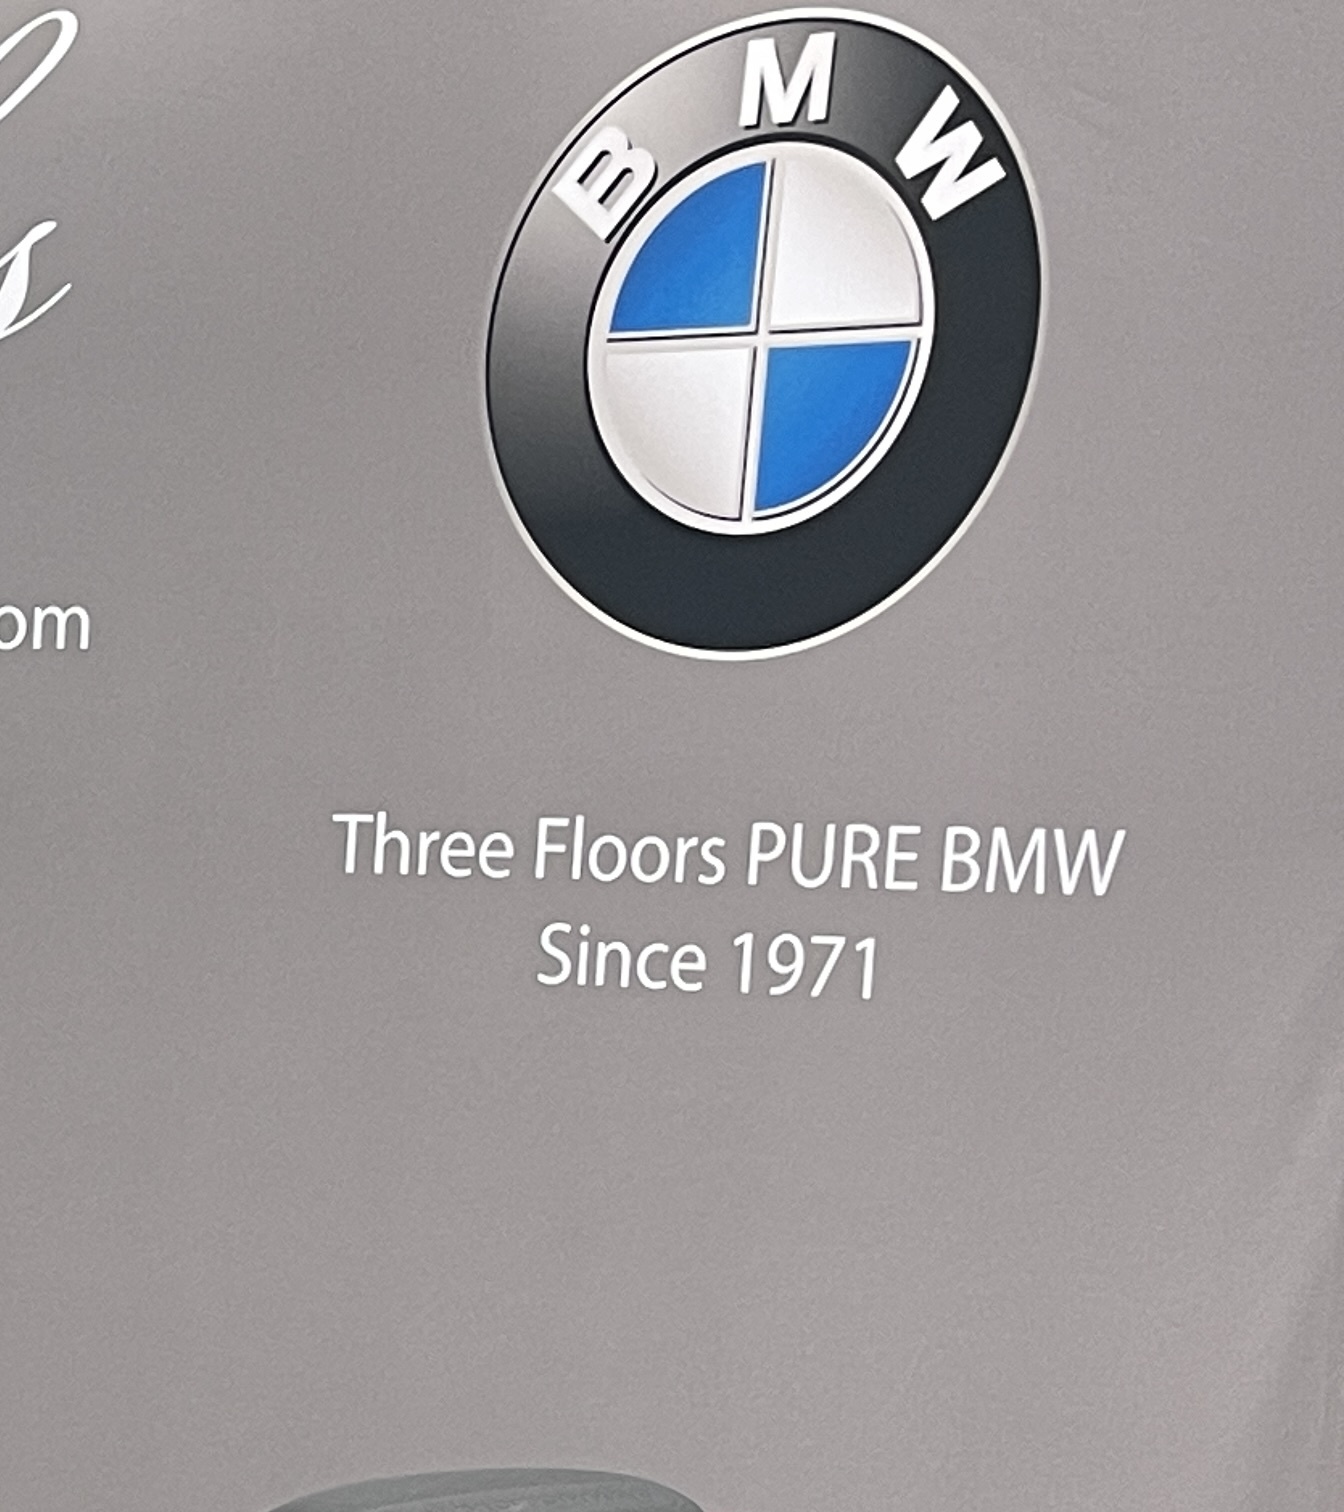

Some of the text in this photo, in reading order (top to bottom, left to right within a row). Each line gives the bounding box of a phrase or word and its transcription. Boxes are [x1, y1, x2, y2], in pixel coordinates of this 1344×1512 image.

[550, 31, 1007, 242] BMW
[331, 811, 1127, 896] Three Floors PURE BMW
[536, 922, 877, 1000] Since 1971
